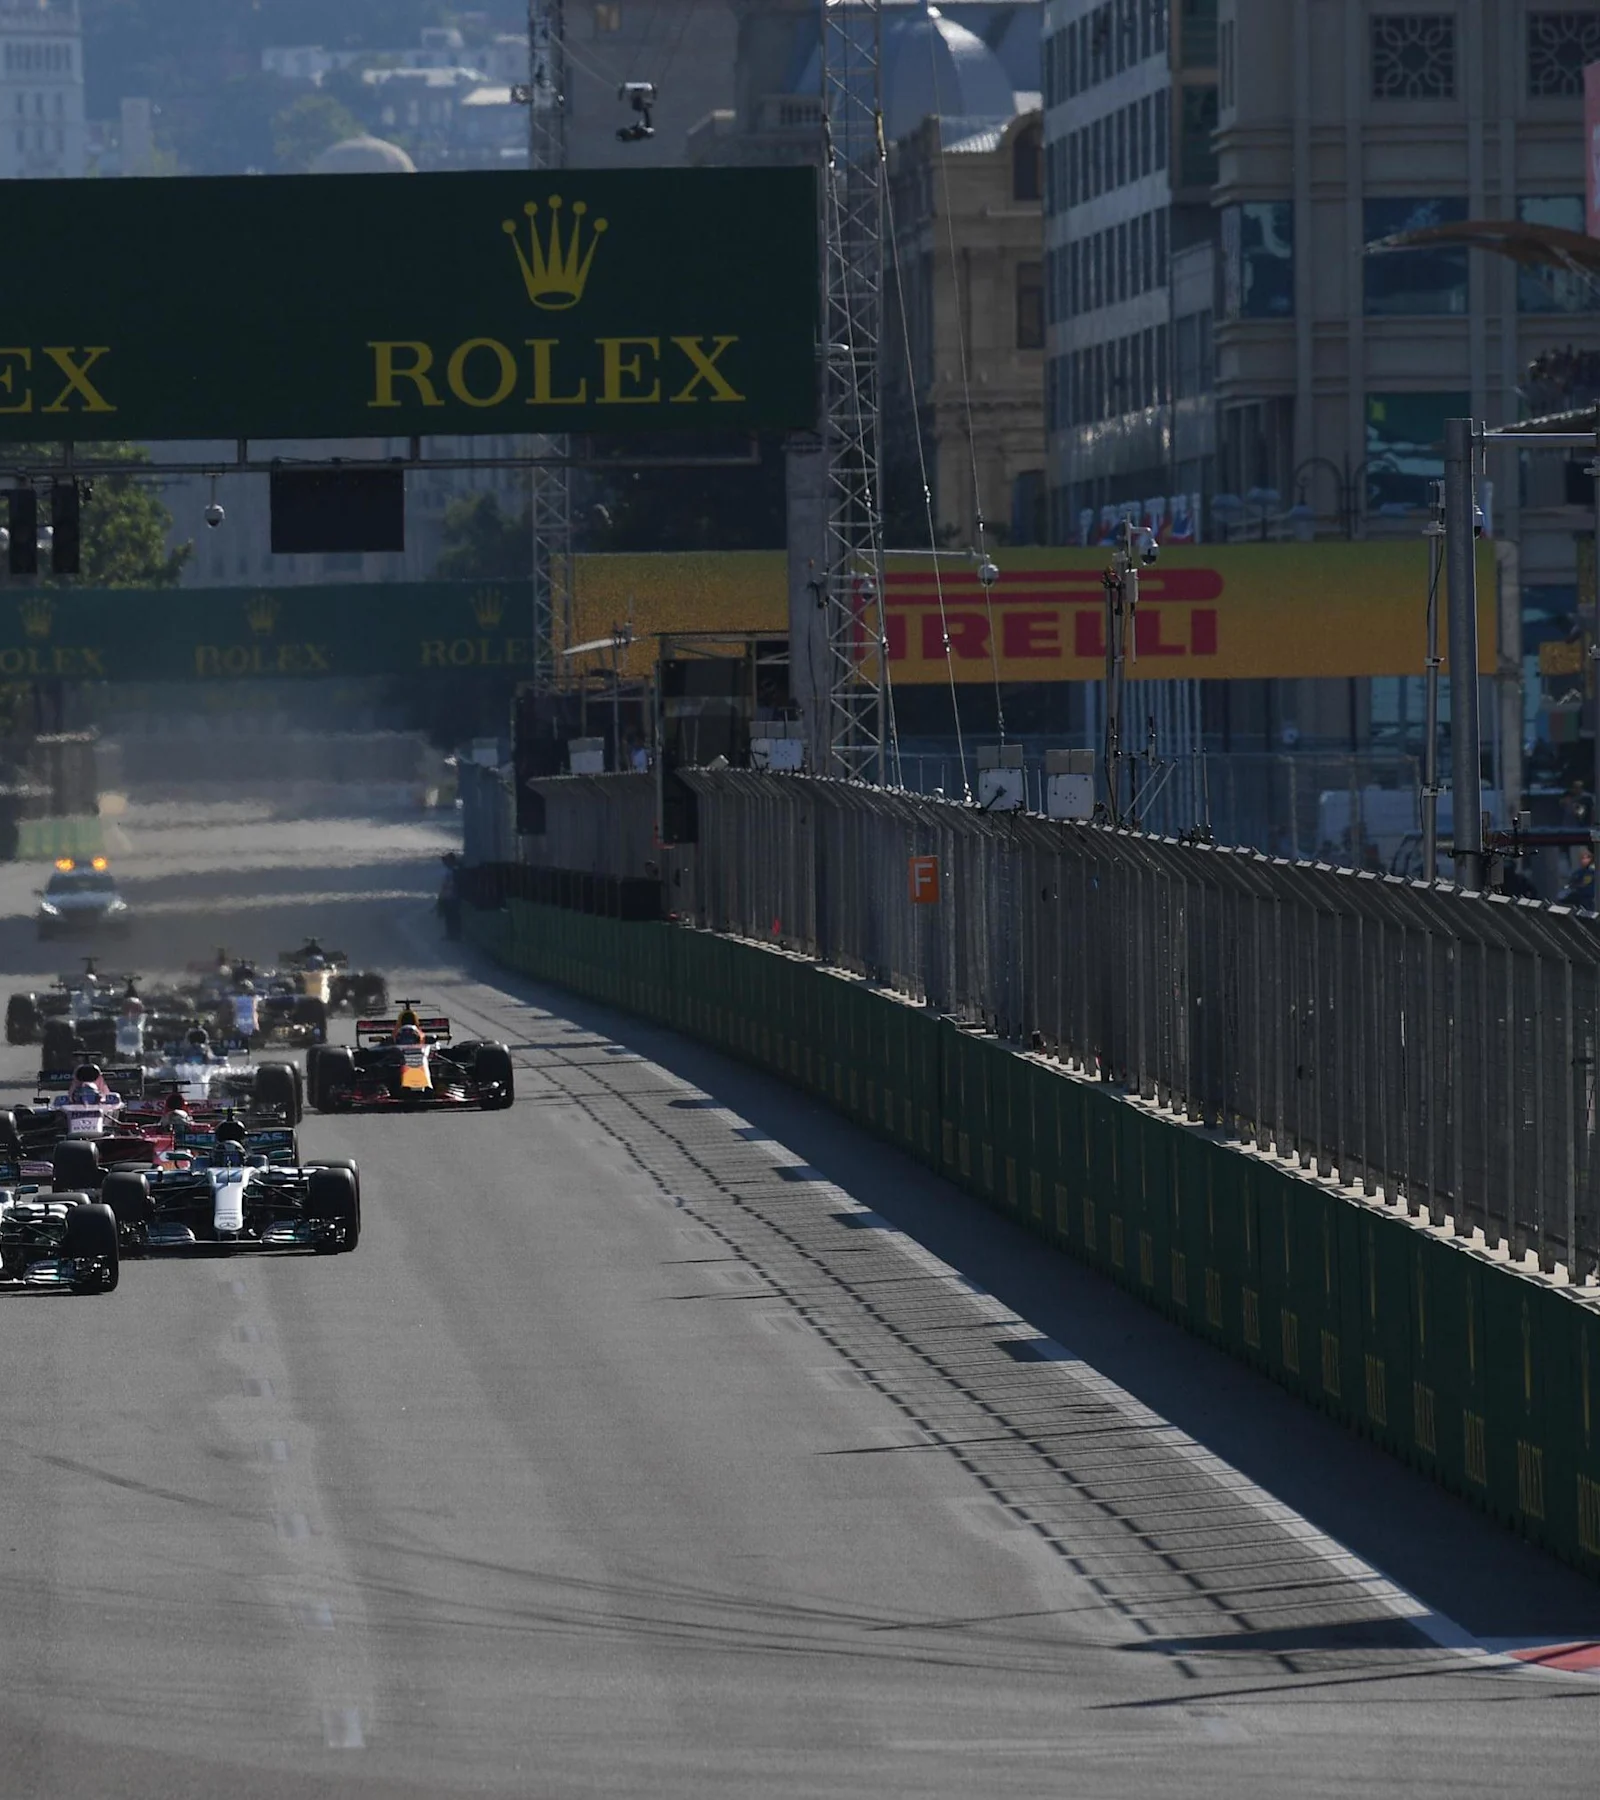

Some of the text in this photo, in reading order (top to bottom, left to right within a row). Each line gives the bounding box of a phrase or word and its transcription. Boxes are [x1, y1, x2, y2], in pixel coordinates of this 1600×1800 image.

[366, 335, 746, 408] ROLEX
[420, 637, 552, 667] ROLE
[914, 862, 933, 897] F
